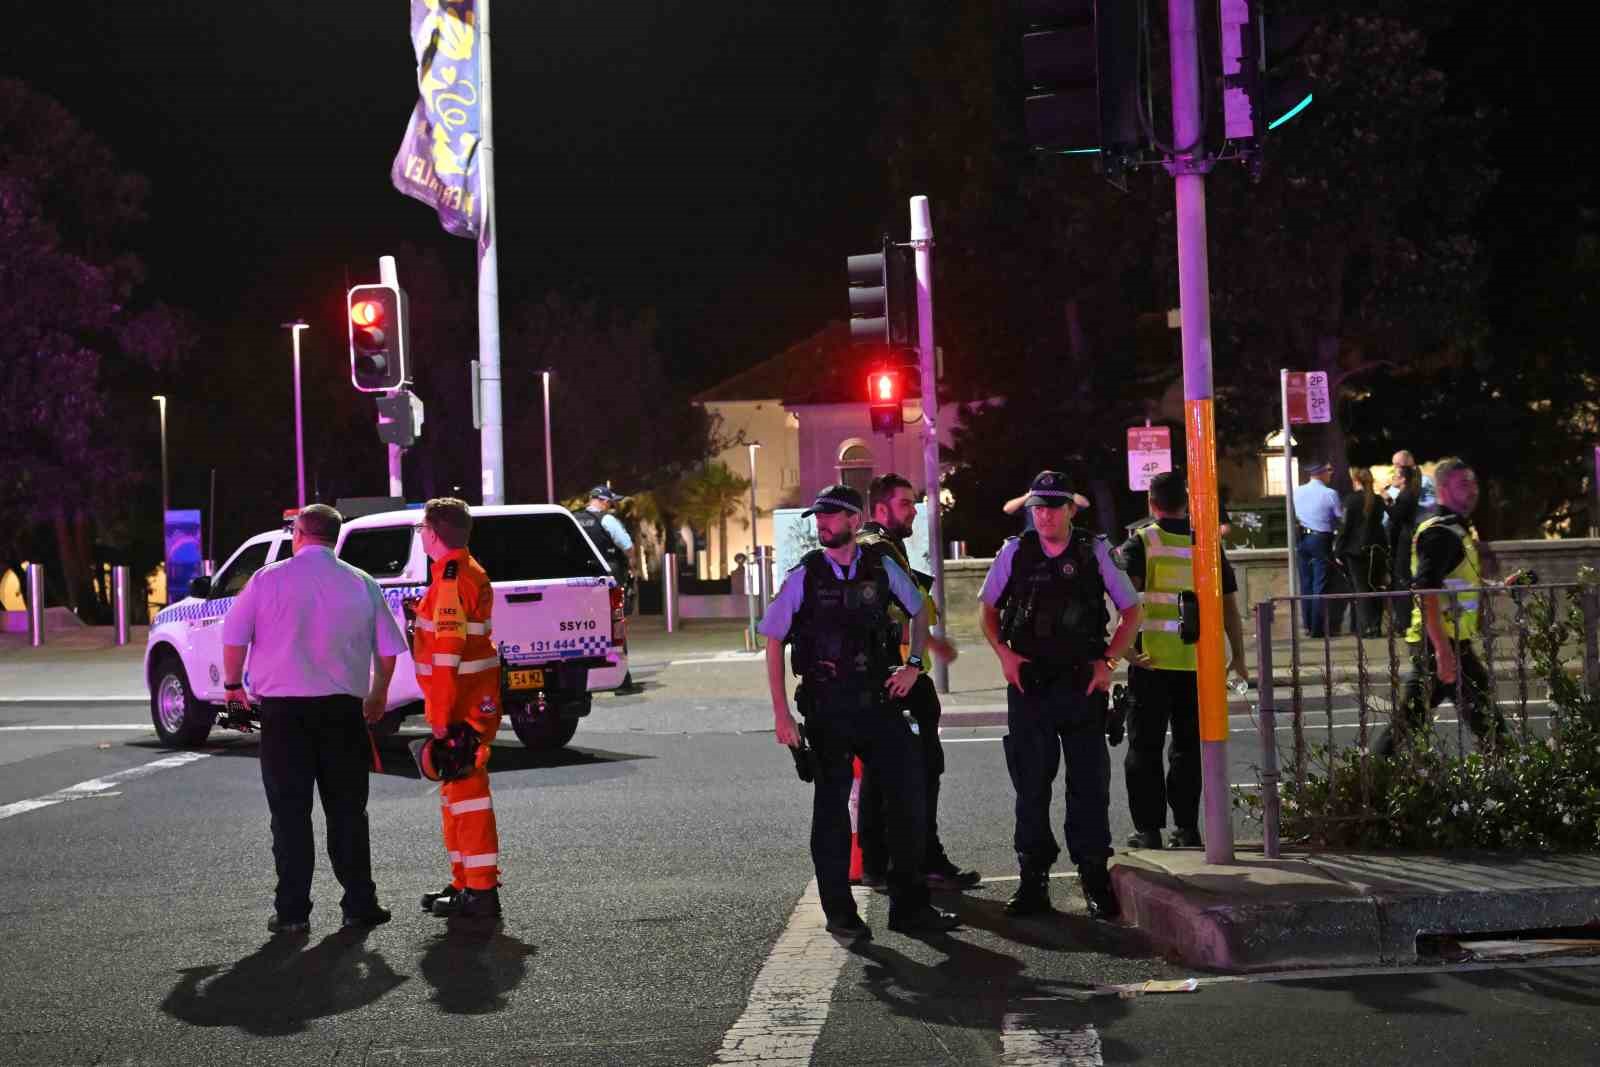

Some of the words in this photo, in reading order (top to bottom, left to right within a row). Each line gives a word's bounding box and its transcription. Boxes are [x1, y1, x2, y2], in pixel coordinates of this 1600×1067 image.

[1310, 375, 1323, 386] 2P
[1142, 462, 1159, 472] 4P
[559, 620, 596, 631] SSY10
[530, 641, 550, 652] 131
[553, 639, 576, 650] 444
